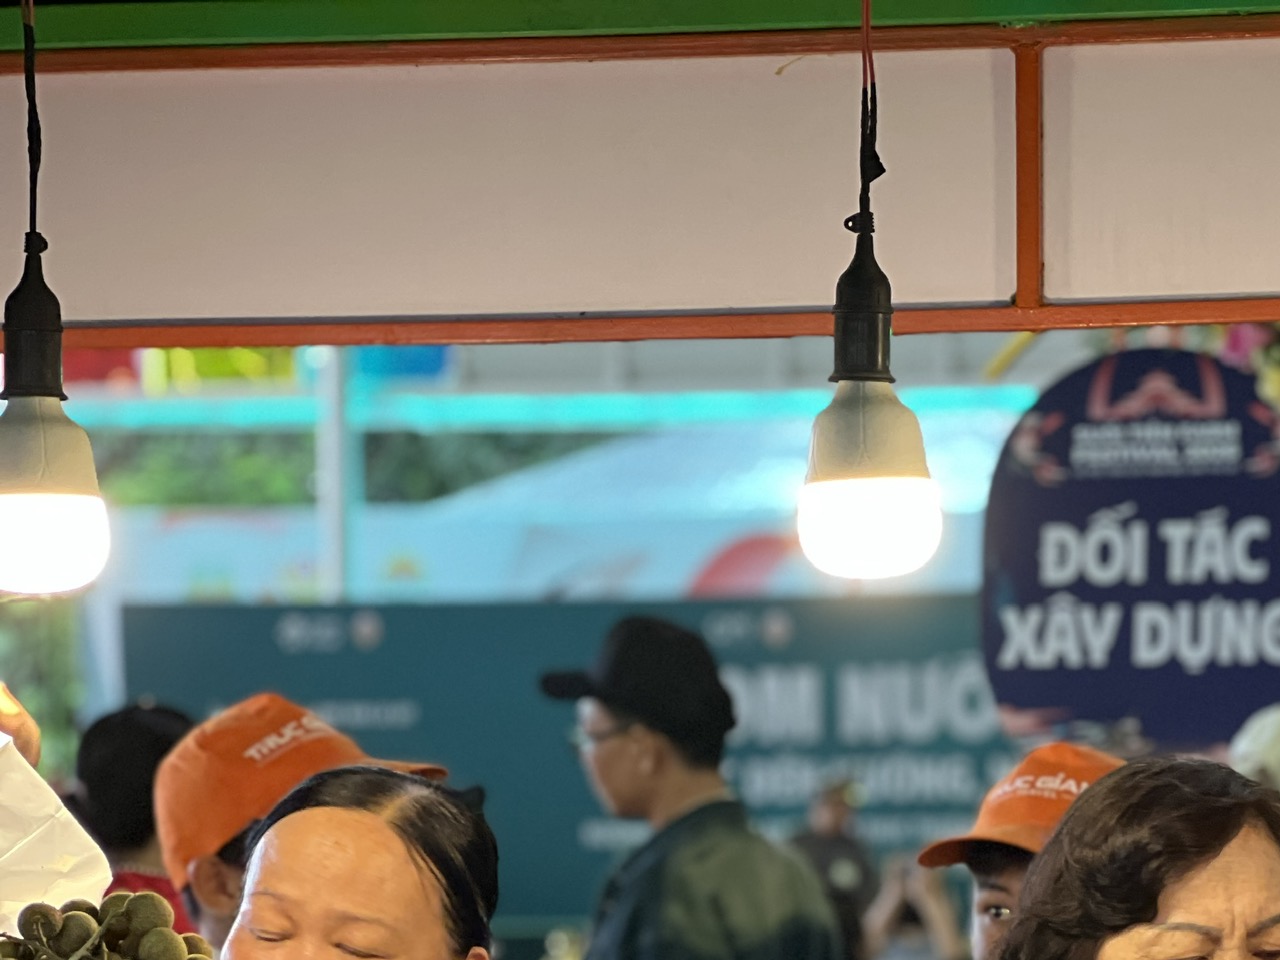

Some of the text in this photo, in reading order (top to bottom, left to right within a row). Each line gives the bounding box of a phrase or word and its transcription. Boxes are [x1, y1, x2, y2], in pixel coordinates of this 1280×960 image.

[1038, 502, 1271, 587] ĐỐI TÁC
[997, 591, 1123, 669] XÂY
